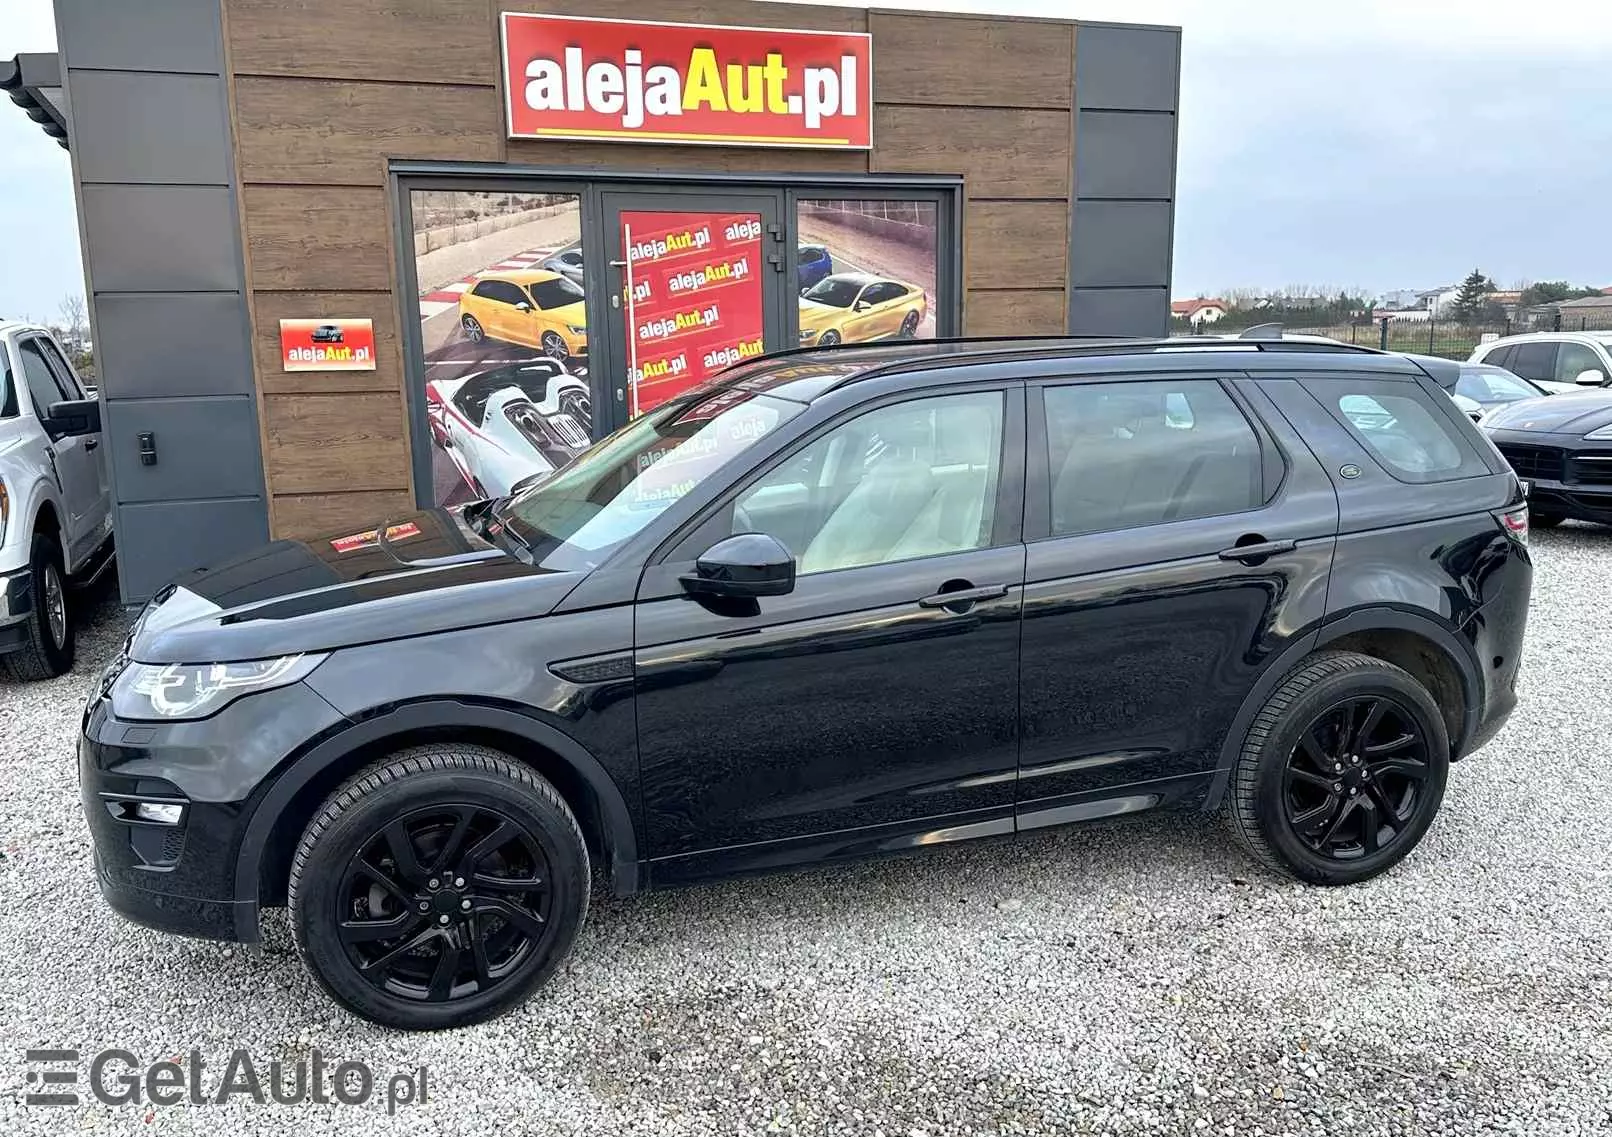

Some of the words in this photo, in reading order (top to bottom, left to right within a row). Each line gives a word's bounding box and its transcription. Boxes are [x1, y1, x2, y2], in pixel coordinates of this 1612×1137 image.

[524, 46, 857, 129] alejaAut.pl
[630, 227, 711, 261] alejaAut.pl
[724, 219, 761, 242] aleja
[668, 258, 749, 292] alejaAut.pl
[639, 305, 719, 340] alejaAut.pl
[288, 346, 370, 364] alejaAut.pl
